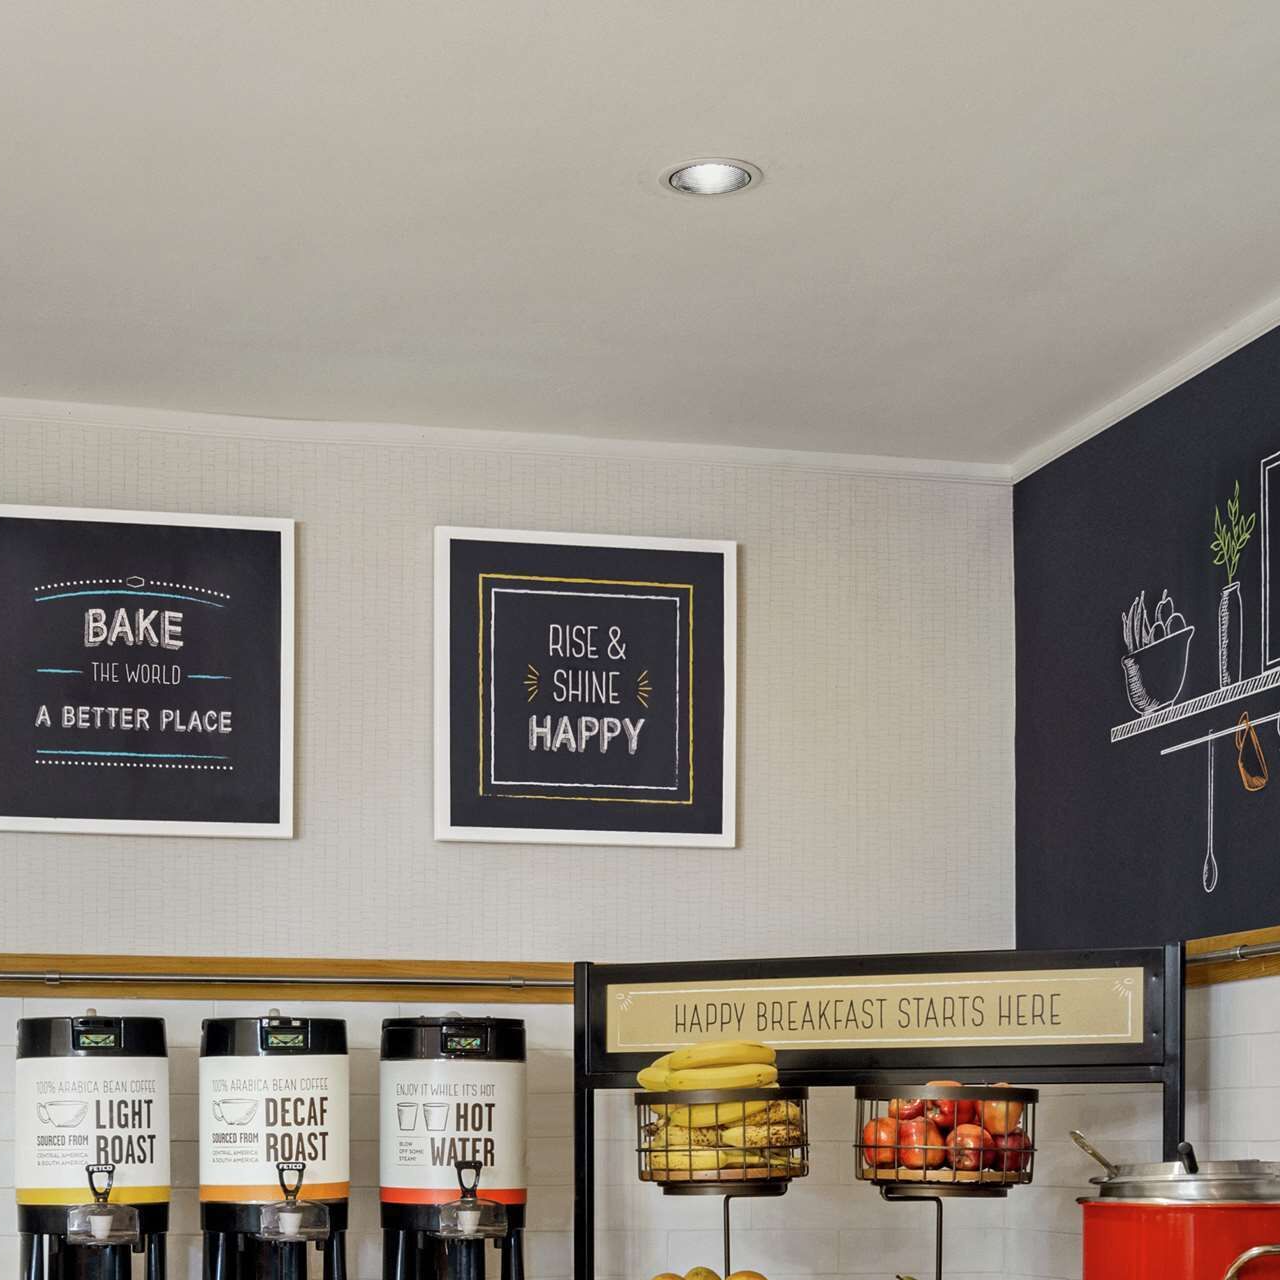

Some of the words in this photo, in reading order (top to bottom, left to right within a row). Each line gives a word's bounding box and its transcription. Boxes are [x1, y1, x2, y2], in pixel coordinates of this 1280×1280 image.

[84, 608, 184, 650] BAKE
[549, 624, 599, 659] RISE
[607, 626, 626, 660] &
[91, 662, 119, 683] THE
[125, 664, 181, 685] WORLD
[553, 669, 620, 704] SHINE
[35, 705, 51, 727] A
[62, 706, 150, 731] BETTER
[160, 709, 232, 734] PLACE
[528, 714, 645, 755] HAPPY
[674, 1002, 746, 1034] HAPPY
[756, 998, 888, 1033] BREAKFAST
[897, 995, 985, 1029] STARTS
[997, 993, 1062, 1027] HERE
[58, 1080, 99, 1094] ARABICA
[103, 1080, 127, 1094] BEAN
[130, 1079, 156, 1093] COFFEE
[230, 1079, 269, 1091] ARABICA
[272, 1078, 297, 1091] BEAN
[300, 1077, 328, 1091] COFFEE
[396, 1083, 418, 1096] ENJOY
[421, 1083, 428, 1096] IT
[430, 1083, 459, 1096] WHILE
[462, 1084, 477, 1096] IT'S
[480, 1084, 495, 1096] HOT
[95, 1099, 153, 1129] LIGHT
[265, 1096, 328, 1127] DECAF
[456, 1102, 495, 1132] HOT
[36, 1135, 66, 1146] SOURCED
[68, 1134, 89, 1146] FROM
[95, 1134, 156, 1165] ROAST
[212, 1132, 237, 1143] SOURCED
[240, 1132, 259, 1143] FROM
[265, 1132, 328, 1162] ROAST
[430, 1137, 495, 1167] WATER
